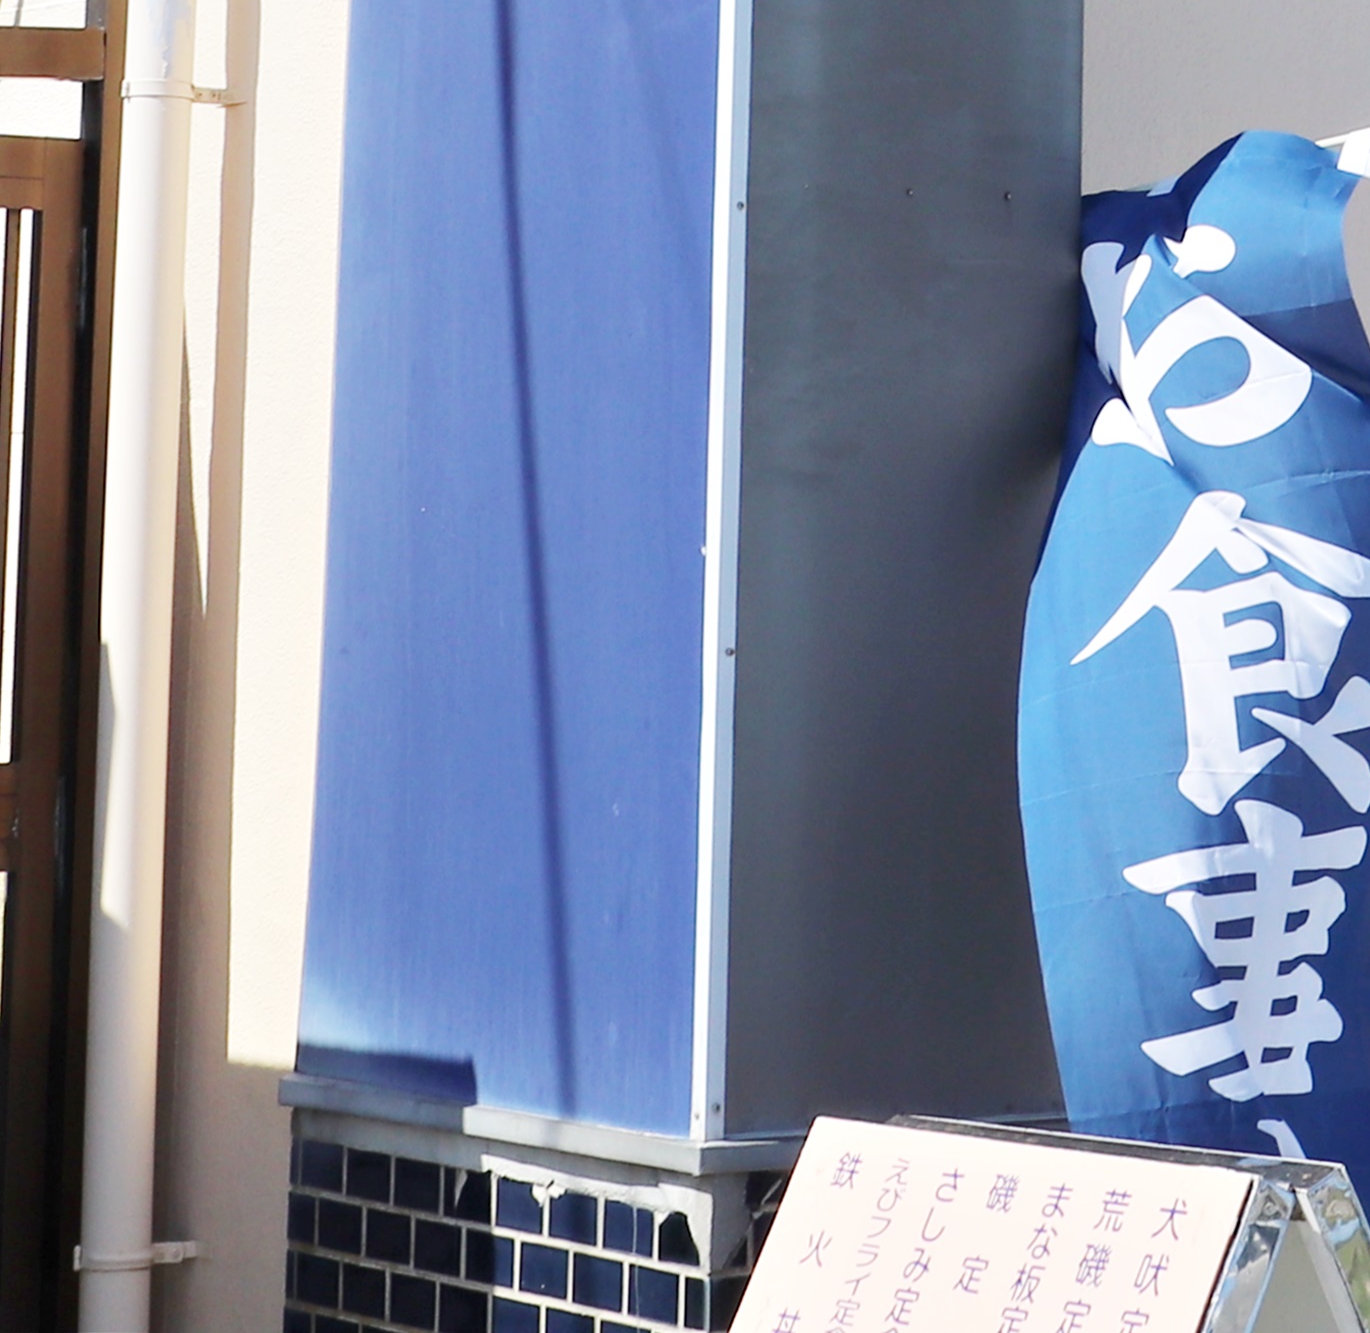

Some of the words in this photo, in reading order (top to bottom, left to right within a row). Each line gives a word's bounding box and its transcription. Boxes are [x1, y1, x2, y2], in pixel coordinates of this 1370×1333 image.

[825, 1158, 910, 1333] えびフライ定
[882, 1168, 965, 1333] さしみ定
